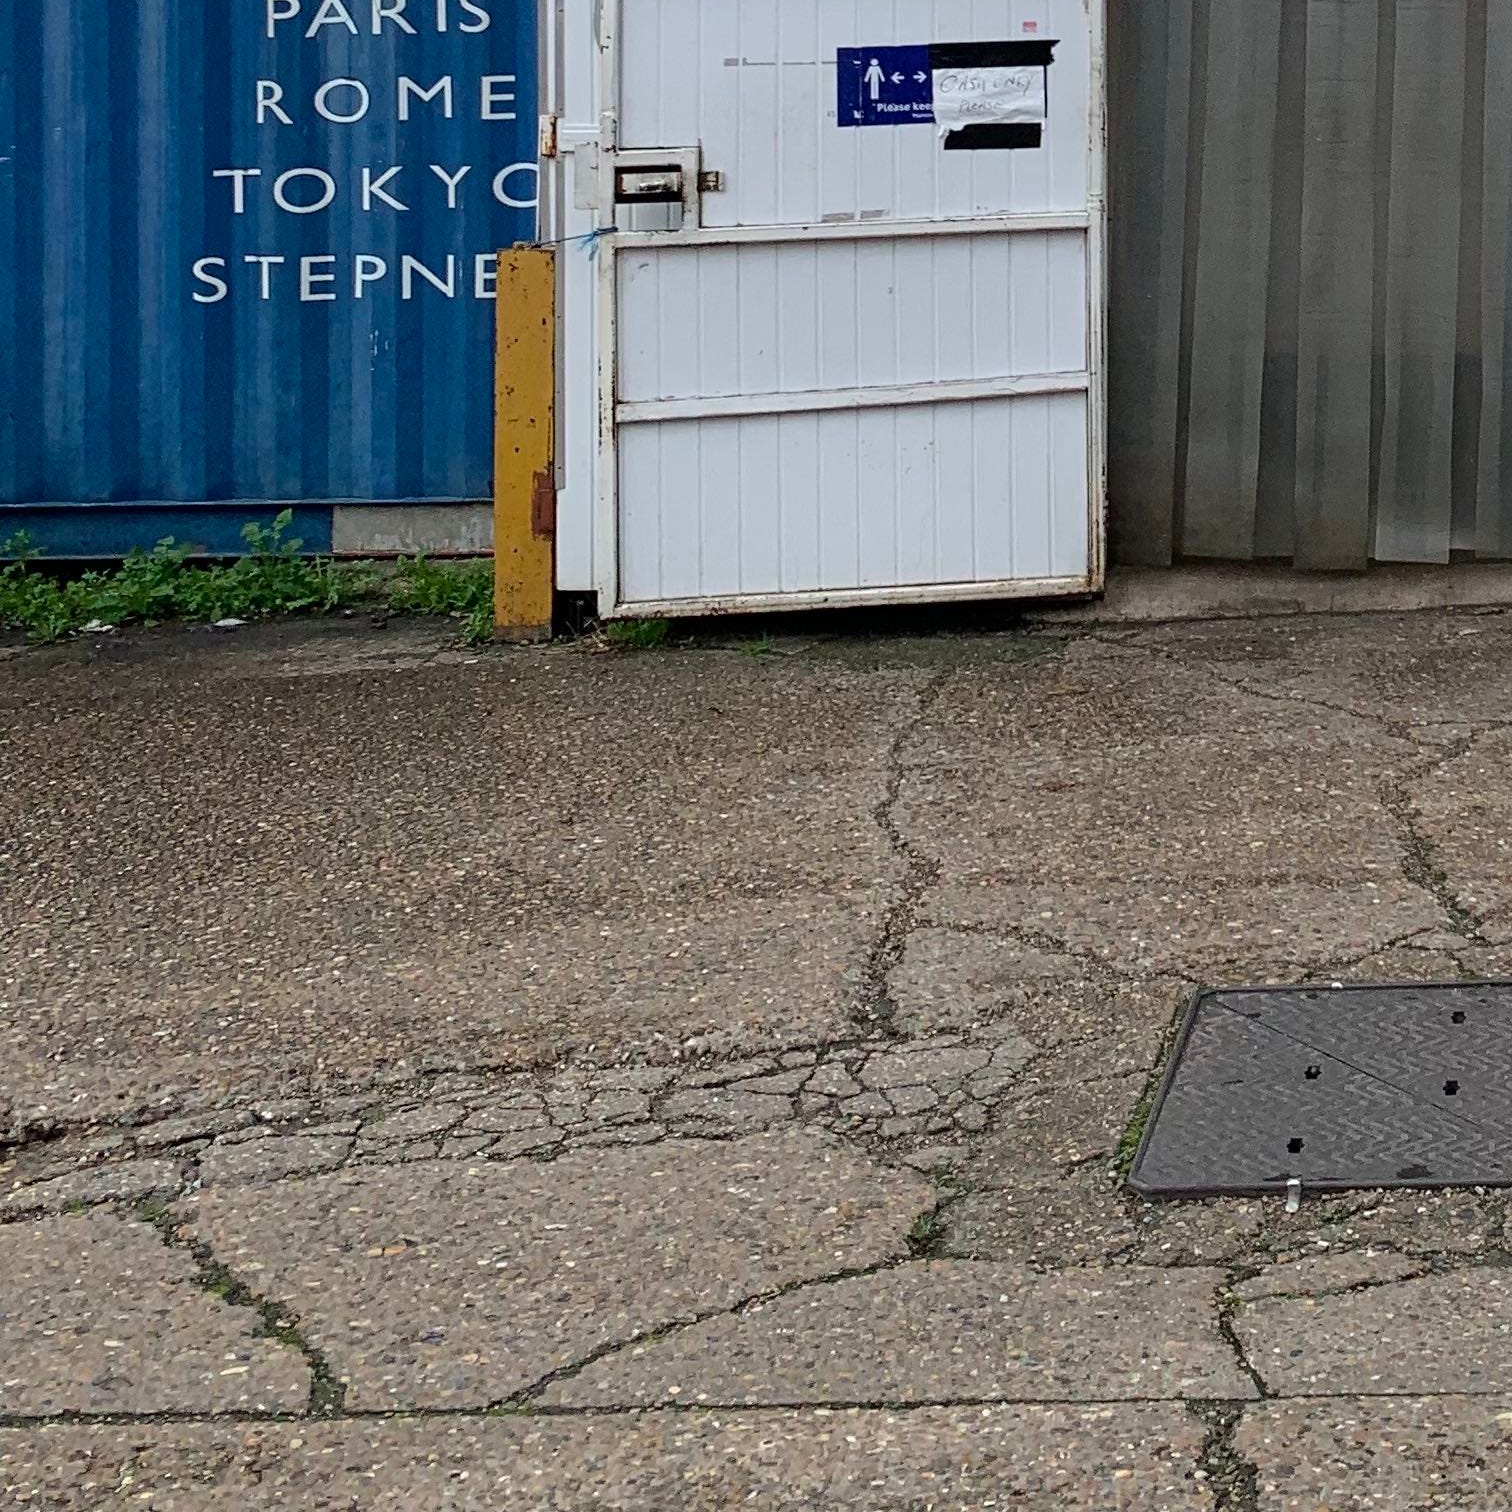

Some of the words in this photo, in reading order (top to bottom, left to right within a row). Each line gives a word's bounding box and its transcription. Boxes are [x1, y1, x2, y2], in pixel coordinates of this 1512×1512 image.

[256, 75, 516, 124] ROME
[877, 103, 911, 112] Please
[912, 102, 933, 111] kee
[192, 254, 497, 303] STEPNE
